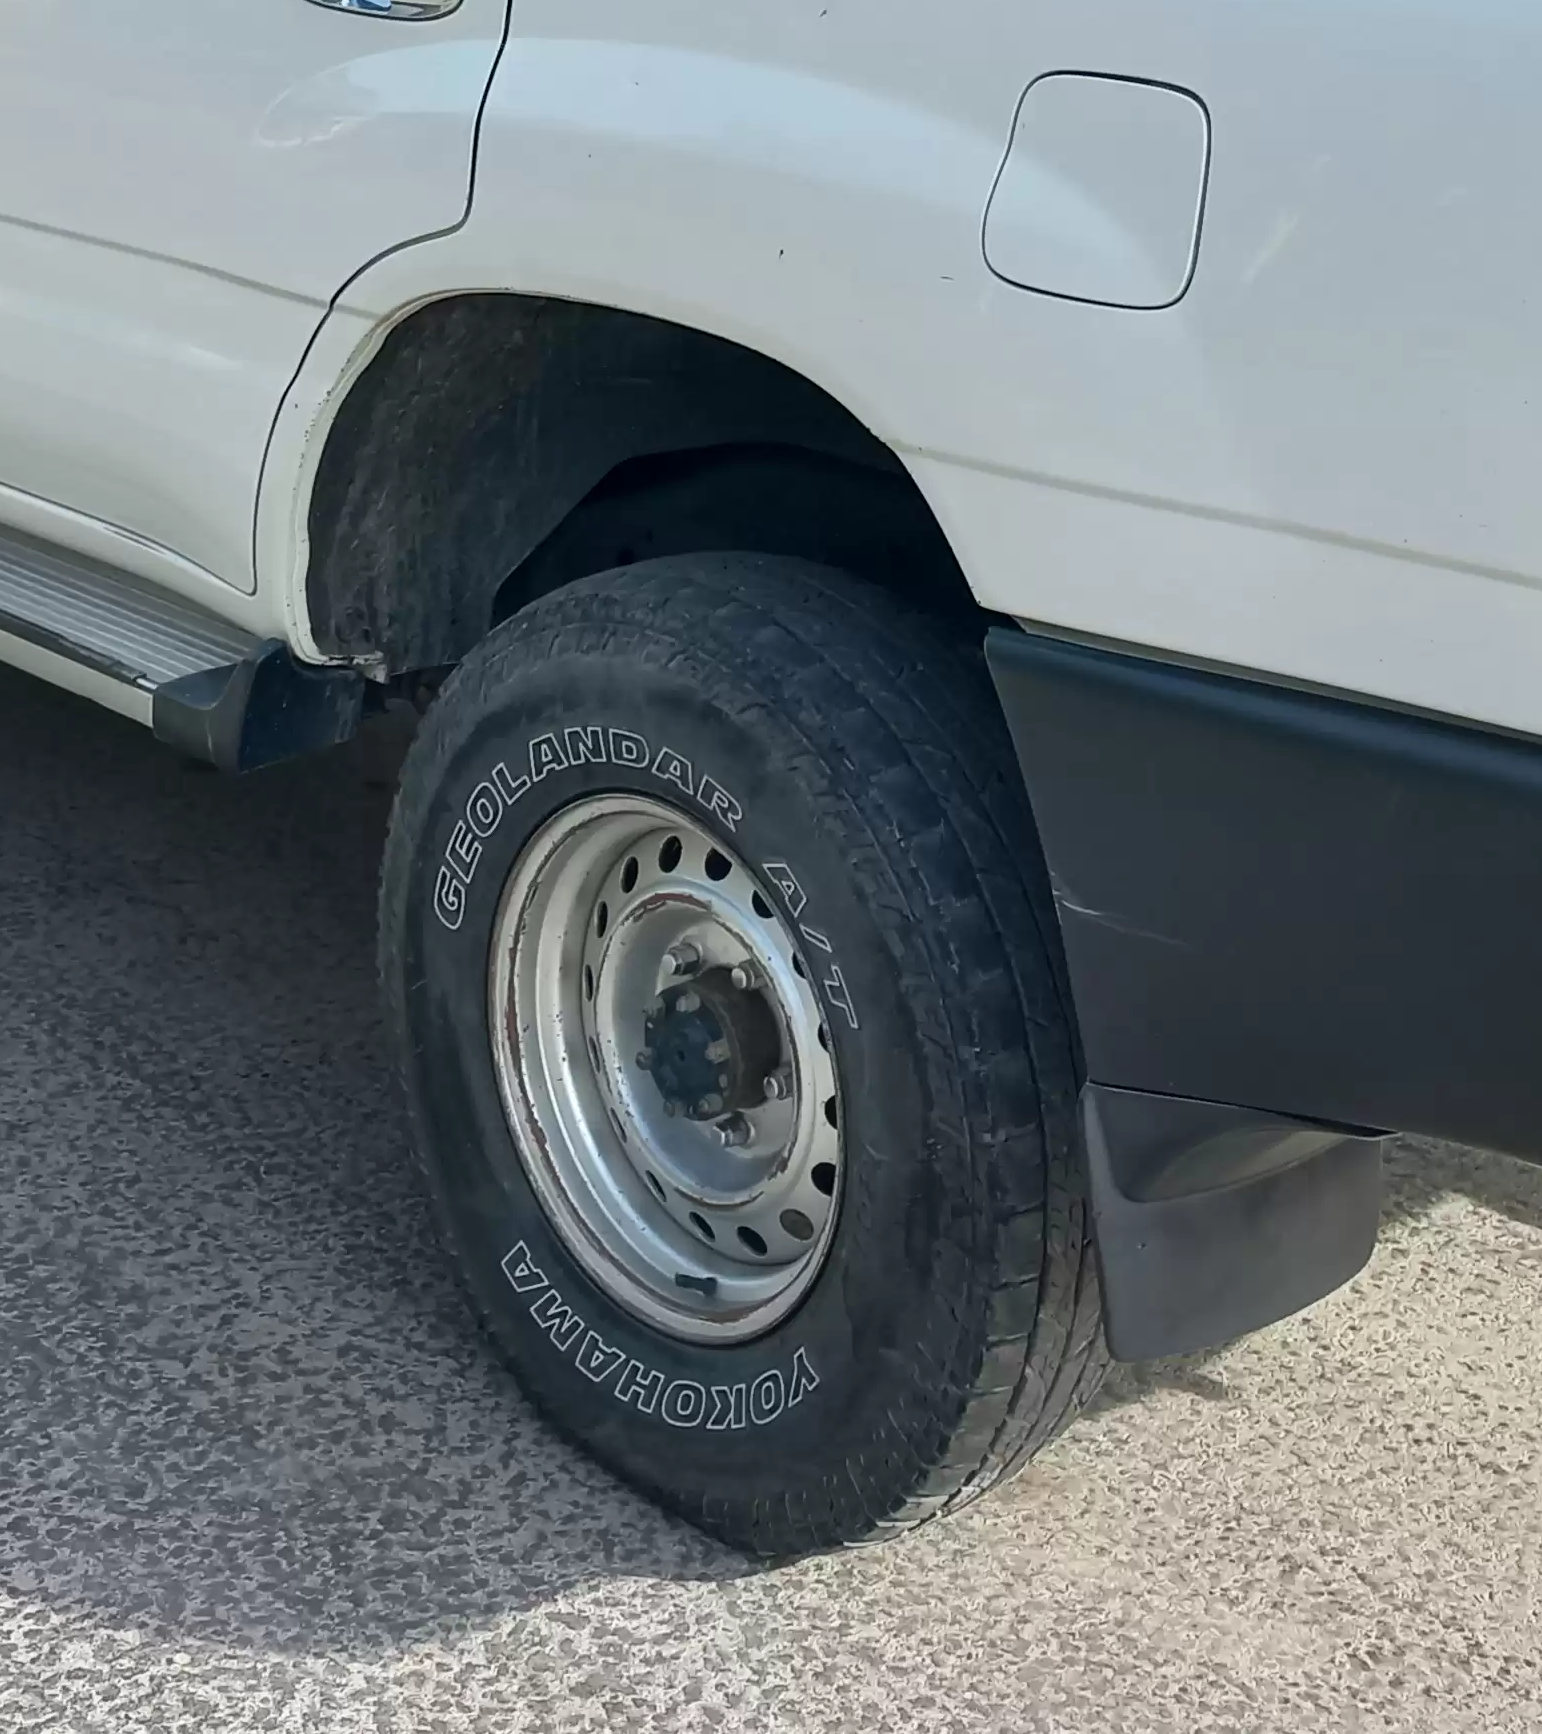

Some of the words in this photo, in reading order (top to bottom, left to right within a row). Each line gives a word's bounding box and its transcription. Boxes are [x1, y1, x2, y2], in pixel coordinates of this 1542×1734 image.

[433, 726, 743, 931] GEOLANDAR
[762, 863, 860, 1030] A/T
[500, 1239, 821, 1430] YOKOHAMA
